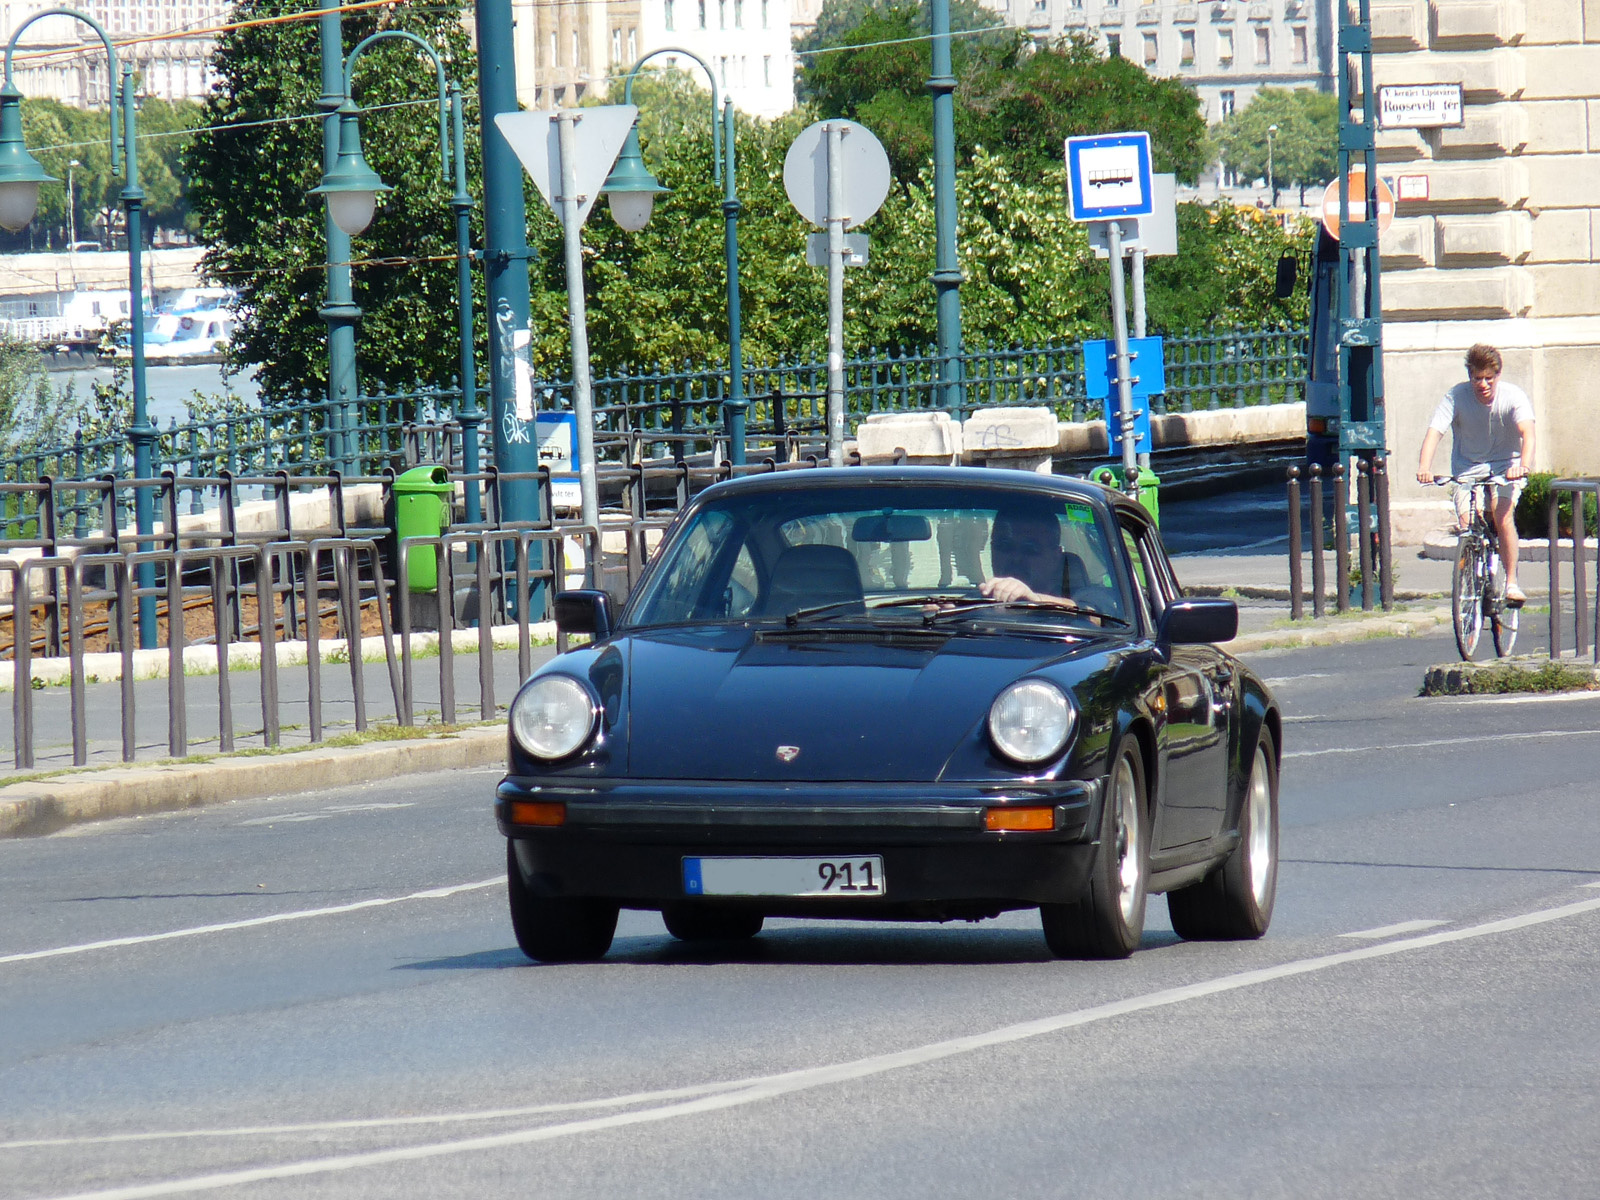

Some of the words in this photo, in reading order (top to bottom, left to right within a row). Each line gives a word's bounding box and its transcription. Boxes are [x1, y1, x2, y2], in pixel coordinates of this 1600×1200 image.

[1384, 99, 1435, 112] Roosevelt
[1443, 98, 1459, 110] tér
[818, 861, 879, 891] 911
